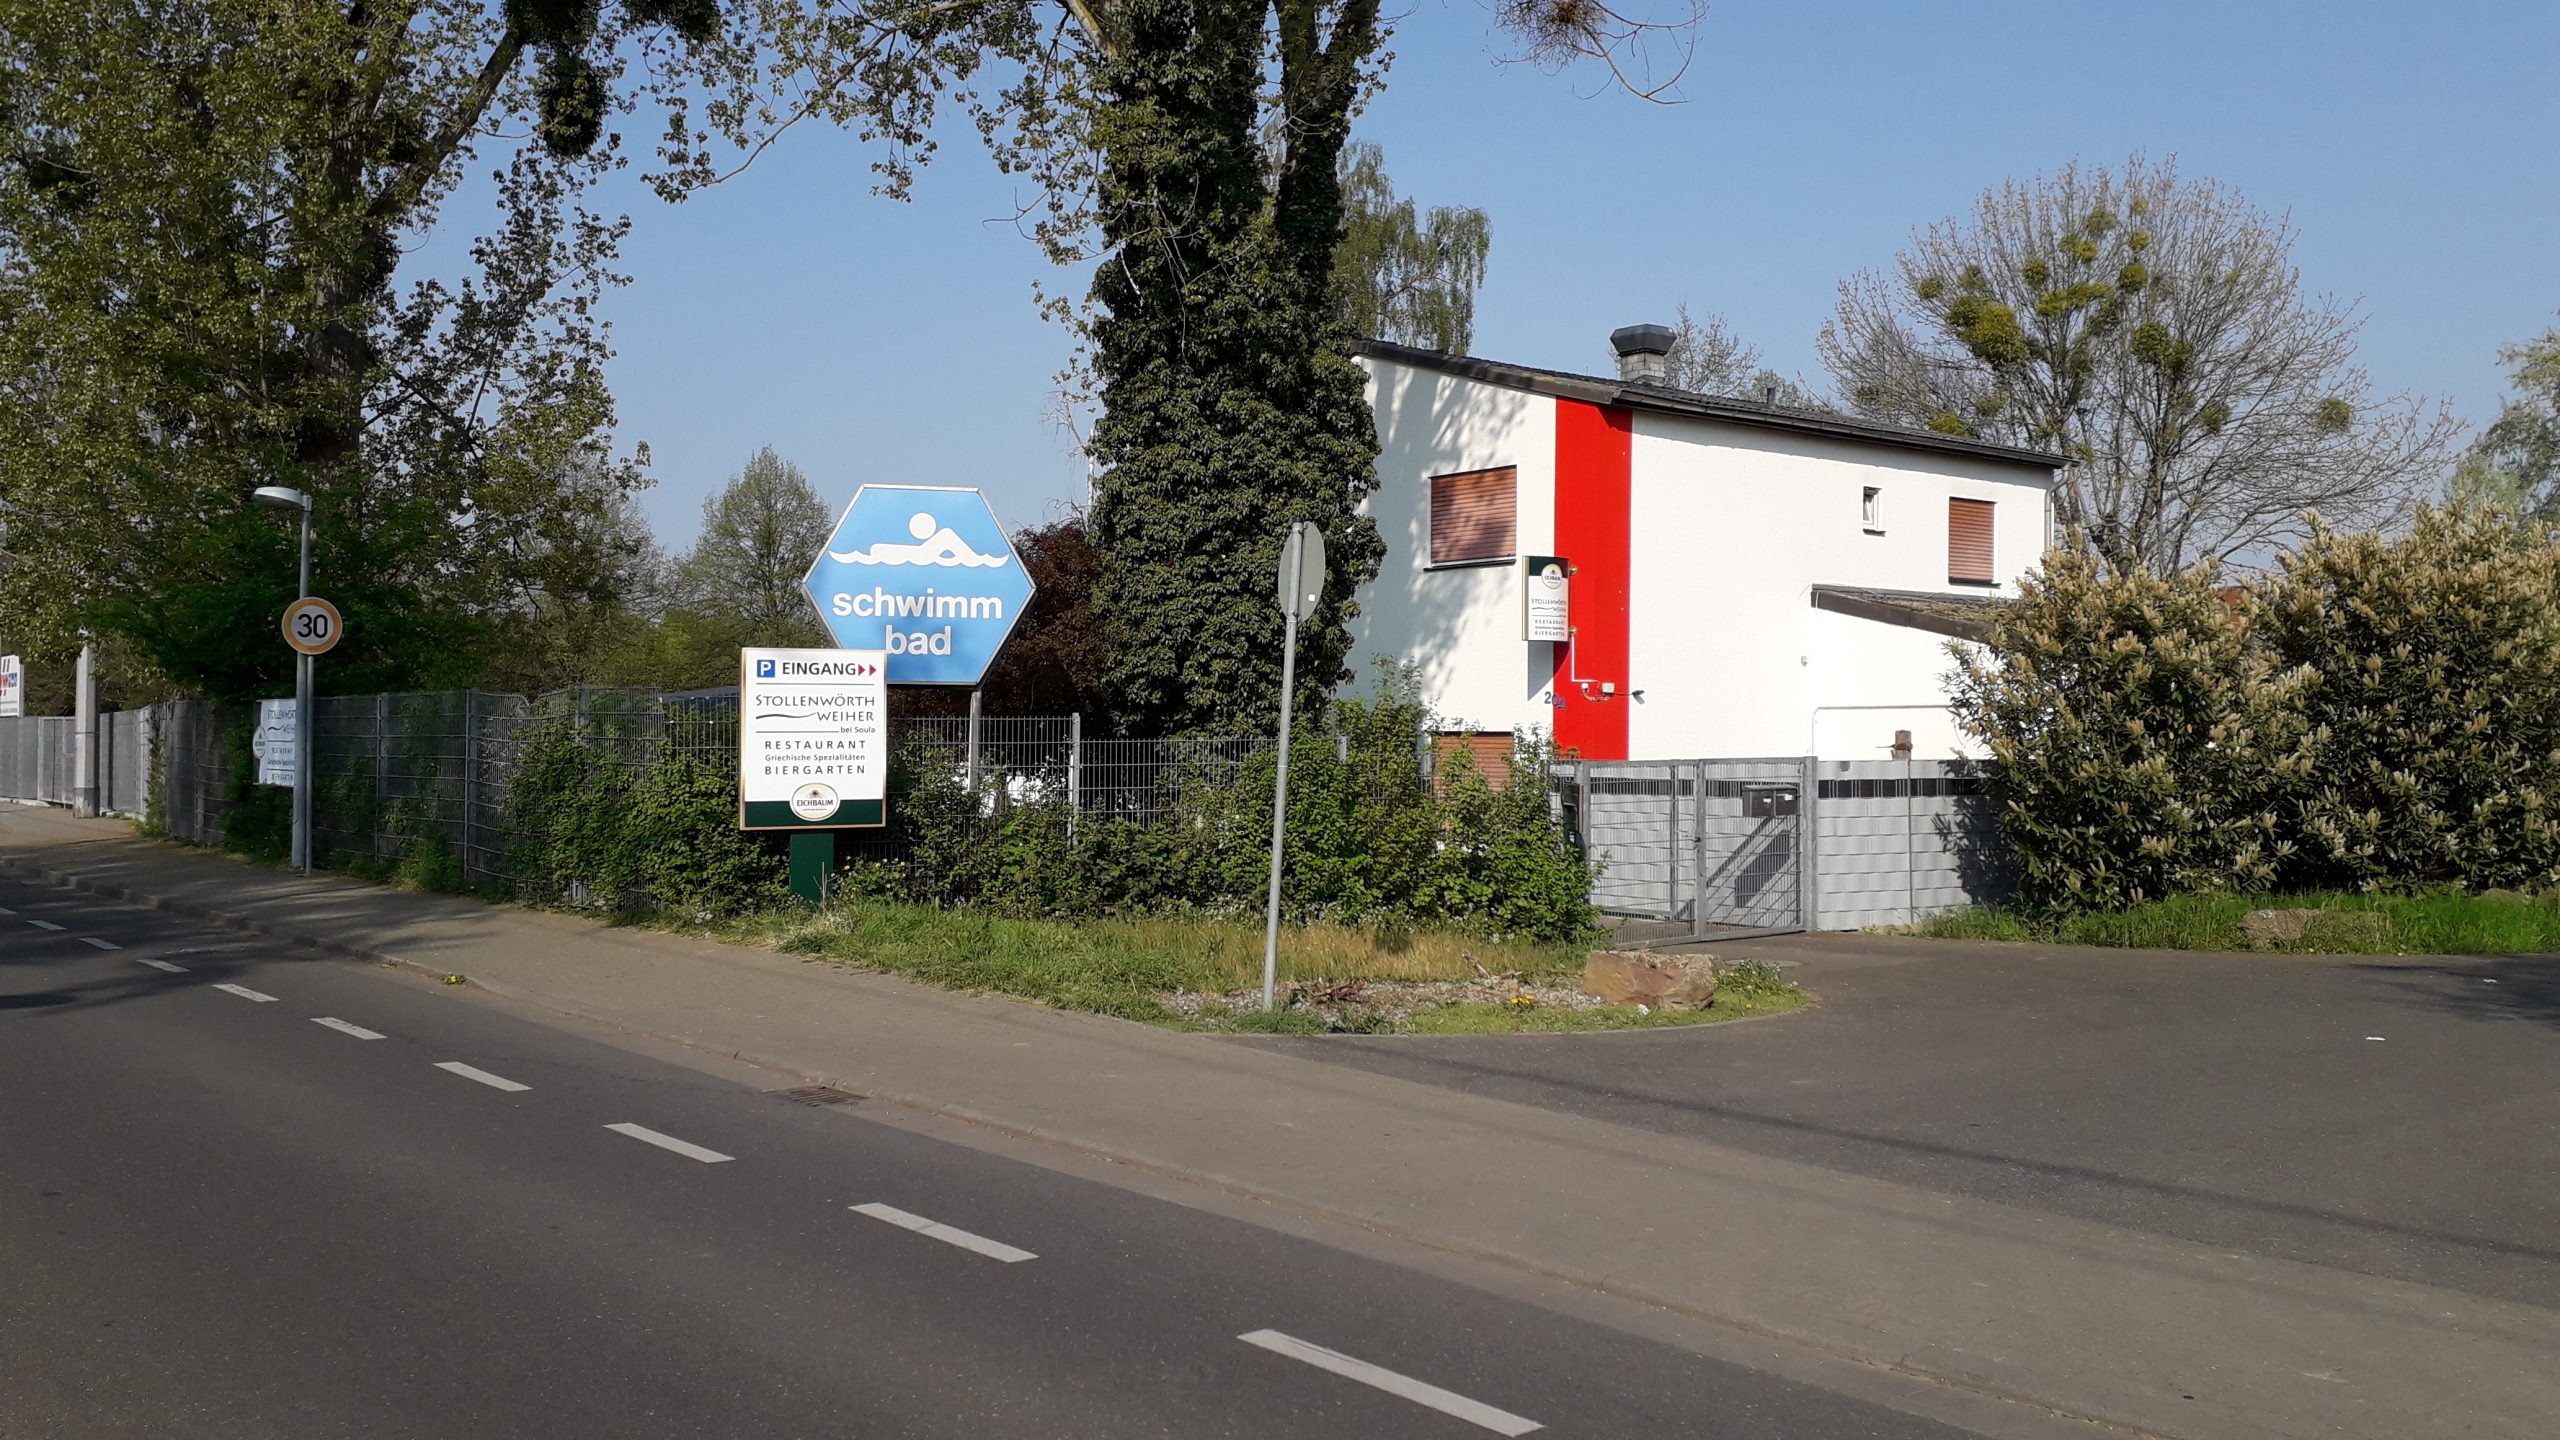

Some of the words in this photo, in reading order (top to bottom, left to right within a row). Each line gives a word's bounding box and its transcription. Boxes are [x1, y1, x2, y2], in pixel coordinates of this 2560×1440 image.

[832, 586, 1003, 619] schwimm
[298, 613, 328, 639] 30
[885, 624, 952, 656] bad
[782, 662, 856, 676] EINGANG
[755, 693, 875, 707] STOLLENWÖRTH
[816, 711, 874, 722] WEIHER
[840, 726, 853, 734] bei
[854, 726, 876, 734] Soula
[765, 740, 866, 750] RESTAURANT
[765, 754, 811, 762] Griechische
[813, 753, 866, 763] Spezialitäten
[765, 765, 865, 775] BIERGARTEN
[796, 799, 834, 807] EICHBAUM
